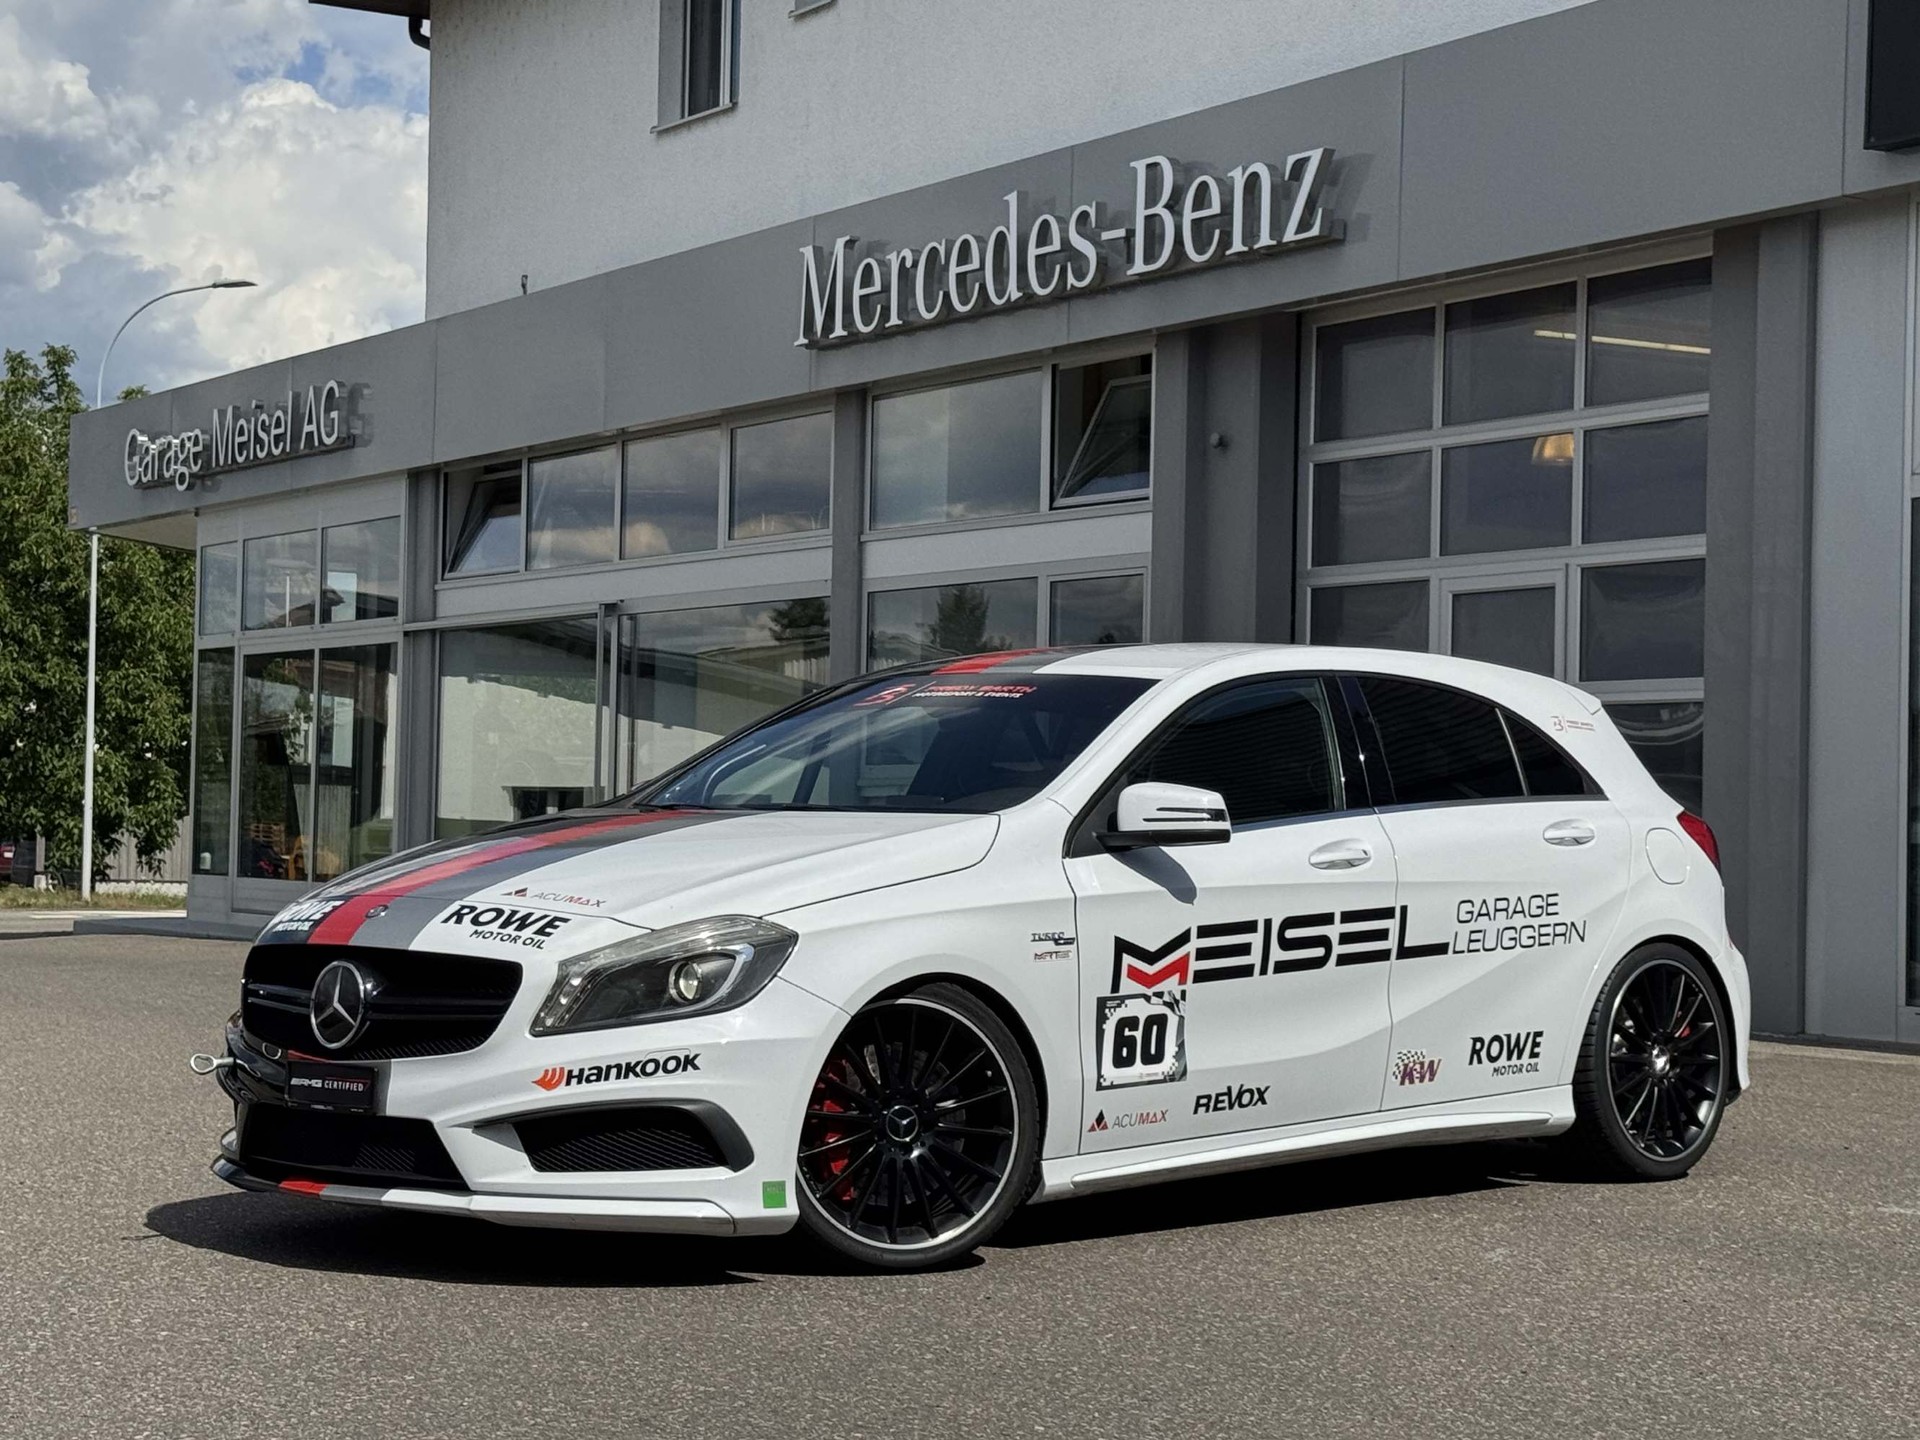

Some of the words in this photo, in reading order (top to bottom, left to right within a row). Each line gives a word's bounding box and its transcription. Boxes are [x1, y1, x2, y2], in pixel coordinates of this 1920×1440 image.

[794, 147, 1334, 347] Mercedes-Benz
[124, 428, 203, 491] Garage
[212, 390, 293, 468] Meisel
[300, 379, 340, 450] AG
[530, 891, 606, 908] ACUMAX
[1456, 893, 1559, 924] GARAGE
[440, 904, 572, 938] ROWE
[1452, 920, 1587, 955] LEUGGERN
[469, 928, 522, 944] MOTOR
[522, 936, 547, 950] OIL
[1110, 904, 1450, 995] MEISEL
[1112, 1013, 1168, 1069] 60
[1468, 1030, 1544, 1065] ROWE
[324, 1081, 364, 1091] CERTIFIED
[1491, 1063, 1524, 1077] MOTOR
[1525, 1061, 1540, 1073] OIL
[1112, 1109, 1168, 1129] ACUMAX
